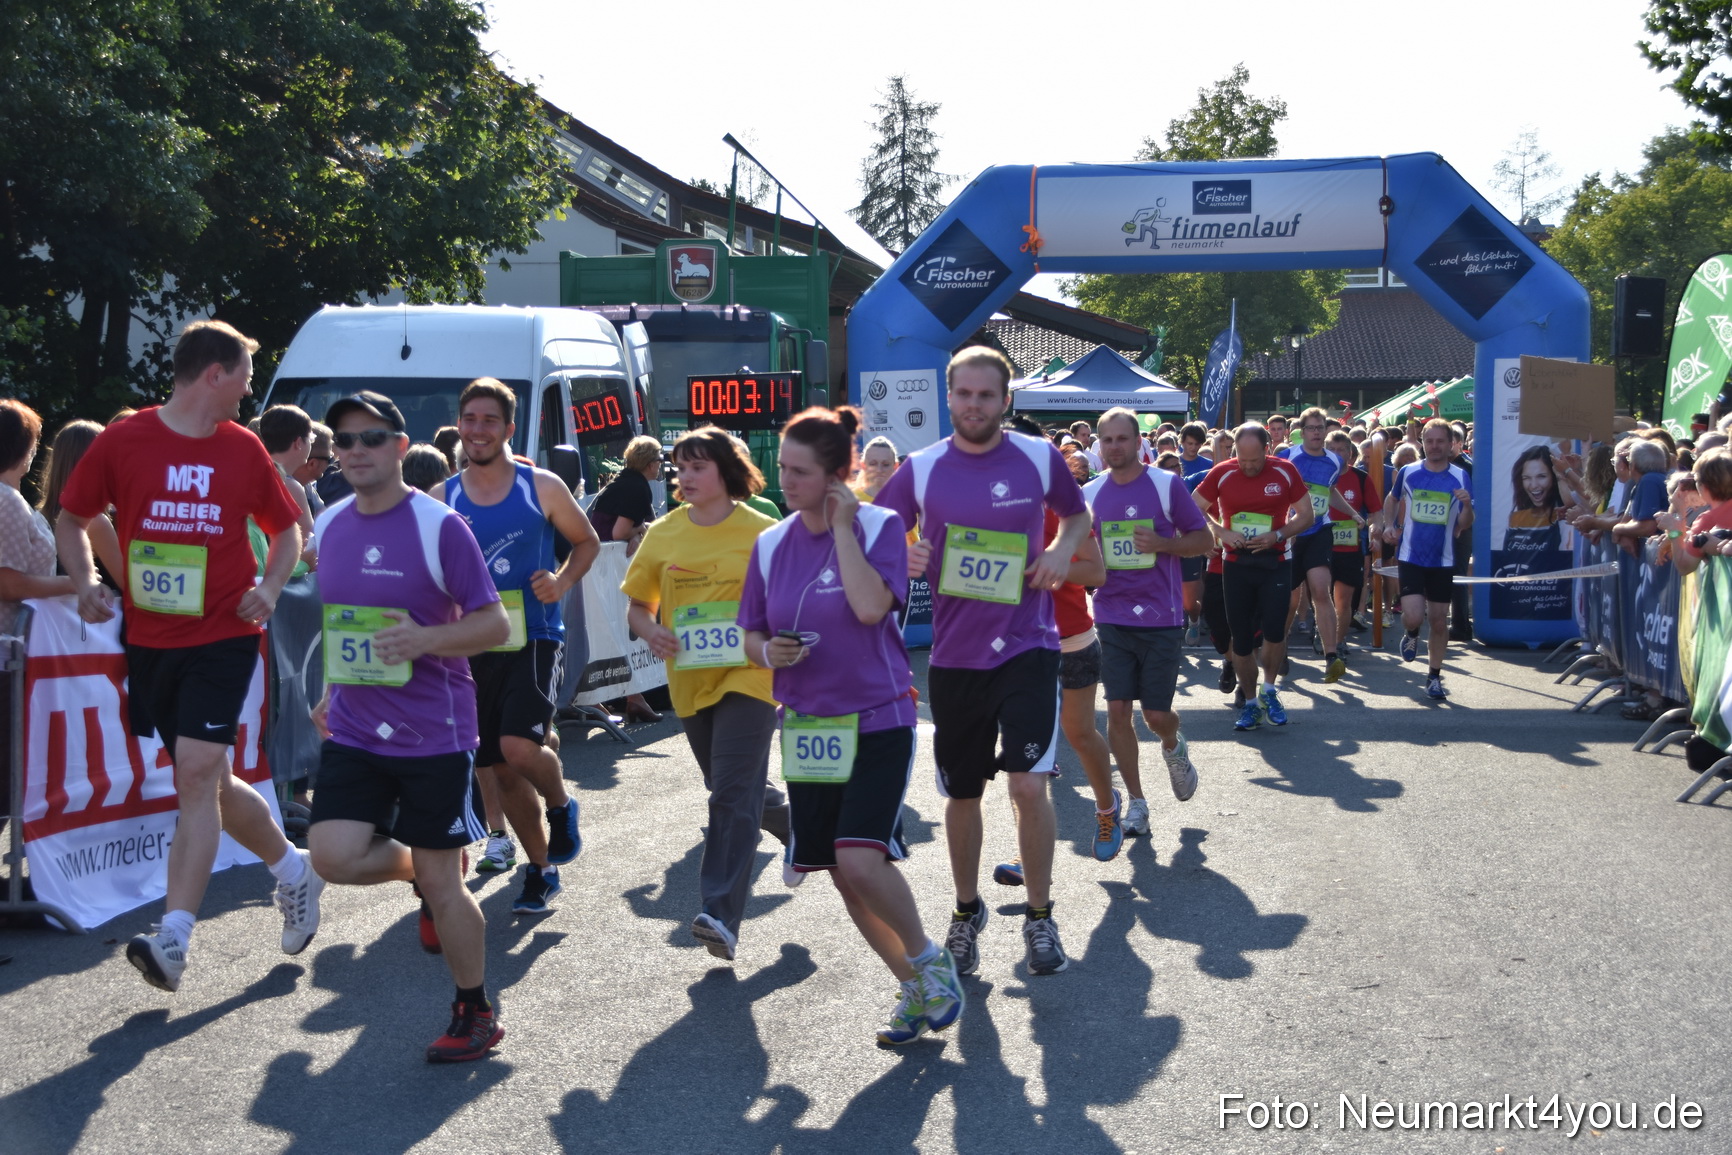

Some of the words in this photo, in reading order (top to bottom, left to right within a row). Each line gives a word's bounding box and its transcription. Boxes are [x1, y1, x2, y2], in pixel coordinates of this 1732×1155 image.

[1205, 192, 1248, 202] Fischer
[1171, 213, 1302, 239] firmenlauf
[1171, 240, 1224, 249] neumarkt
[1440, 255, 1459, 266] und
[1461, 252, 1480, 262] das
[927, 267, 995, 281] Fischer
[682, 289, 703, 297] 1628
[1670, 346, 1709, 397] AOK
[691, 379, 792, 415] 00:03:14
[1047, 397, 1154, 405] www.fischer-automobile.de
[168, 464, 215, 498] MRT
[152, 500, 222, 521] MEIER
[992, 497, 1032, 508] Fertigteilwerke
[1313, 497, 1325, 508] 21
[1415, 502, 1445, 516] 1123
[143, 518, 194, 532] Running
[197, 521, 224, 535] Team
[1334, 531, 1352, 540] 194
[484, 538, 507, 556] Schick
[507, 529, 524, 540] Bau
[361, 568, 404, 577] Fertigteilwerke
[958, 556, 1009, 583] 507
[142, 570, 185, 595] 961
[1644, 602, 1674, 645] cher
[680, 627, 739, 651] 1336
[341, 637, 372, 663] 51
[796, 735, 842, 760] 506
[56, 823, 172, 882] www.meier-
